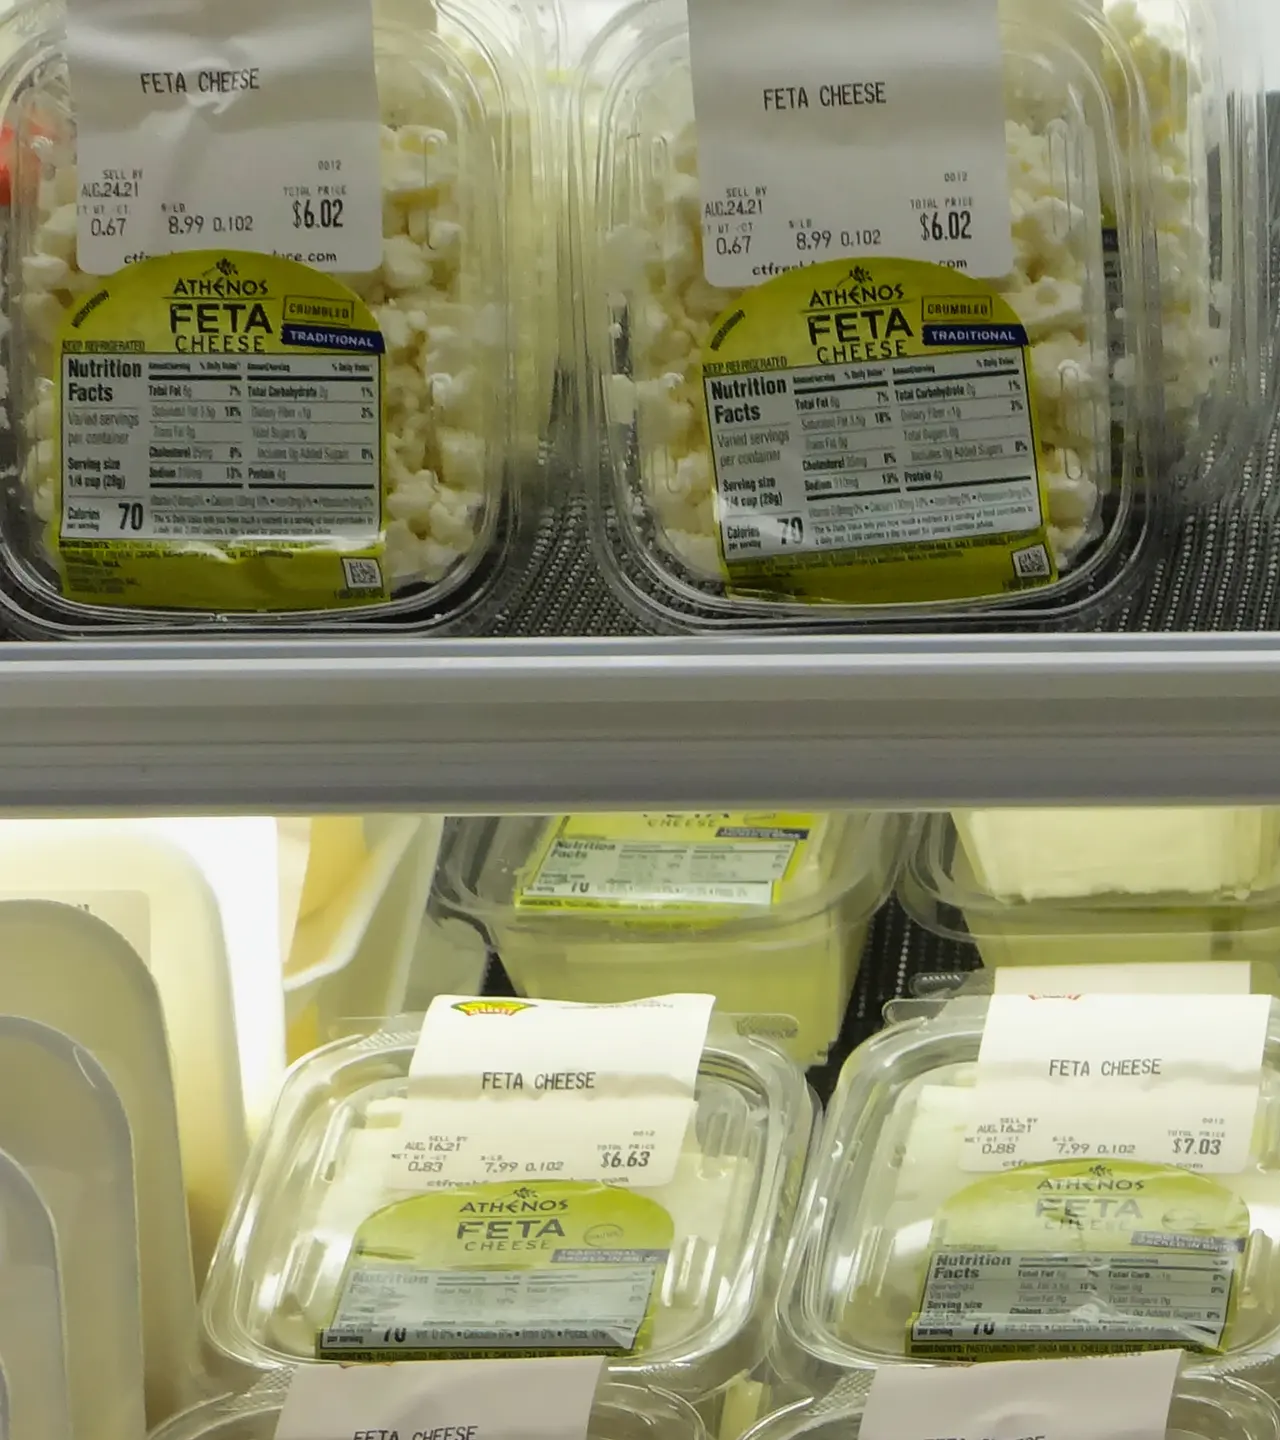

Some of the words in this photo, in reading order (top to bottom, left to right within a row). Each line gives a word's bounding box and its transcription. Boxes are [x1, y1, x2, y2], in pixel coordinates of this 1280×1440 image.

[140, 72, 186, 94] FETA
[198, 68, 260, 93] CHEESE
[764, 86, 809, 110] FETA
[820, 82, 886, 107] CHEESE
[292, 200, 344, 230] $6.02
[920, 210, 972, 241] $6.02
[796, 230, 832, 251] 8.99
[840, 228, 882, 248] 0.102
[173, 278, 269, 296] ATHENOS
[809, 283, 904, 307] ATHENOS
[169, 303, 274, 335] FETA
[807, 308, 913, 346] FETA
[175, 335, 265, 354] CHEESE
[290, 329, 374, 348] TRADITIONAL
[931, 328, 1016, 342] TRADITIONAL
[816, 339, 908, 364] CHEESE
[68, 360, 142, 378] Nutrition
[68, 382, 114, 402] Facts
[710, 376, 787, 399] Nutrition
[715, 402, 760, 424] Facts
[118, 502, 144, 532] 70
[1049, 1060, 1090, 1077] FETA
[1101, 1058, 1162, 1077] CHEESE
[482, 1072, 523, 1091] FETA
[534, 1072, 596, 1090] CHEESE
[1172, 1139, 1221, 1156] $7.03
[600, 1151, 650, 1168] $6.63
[459, 1199, 569, 1214] ATHENOS
[457, 1218, 565, 1240] FETA
